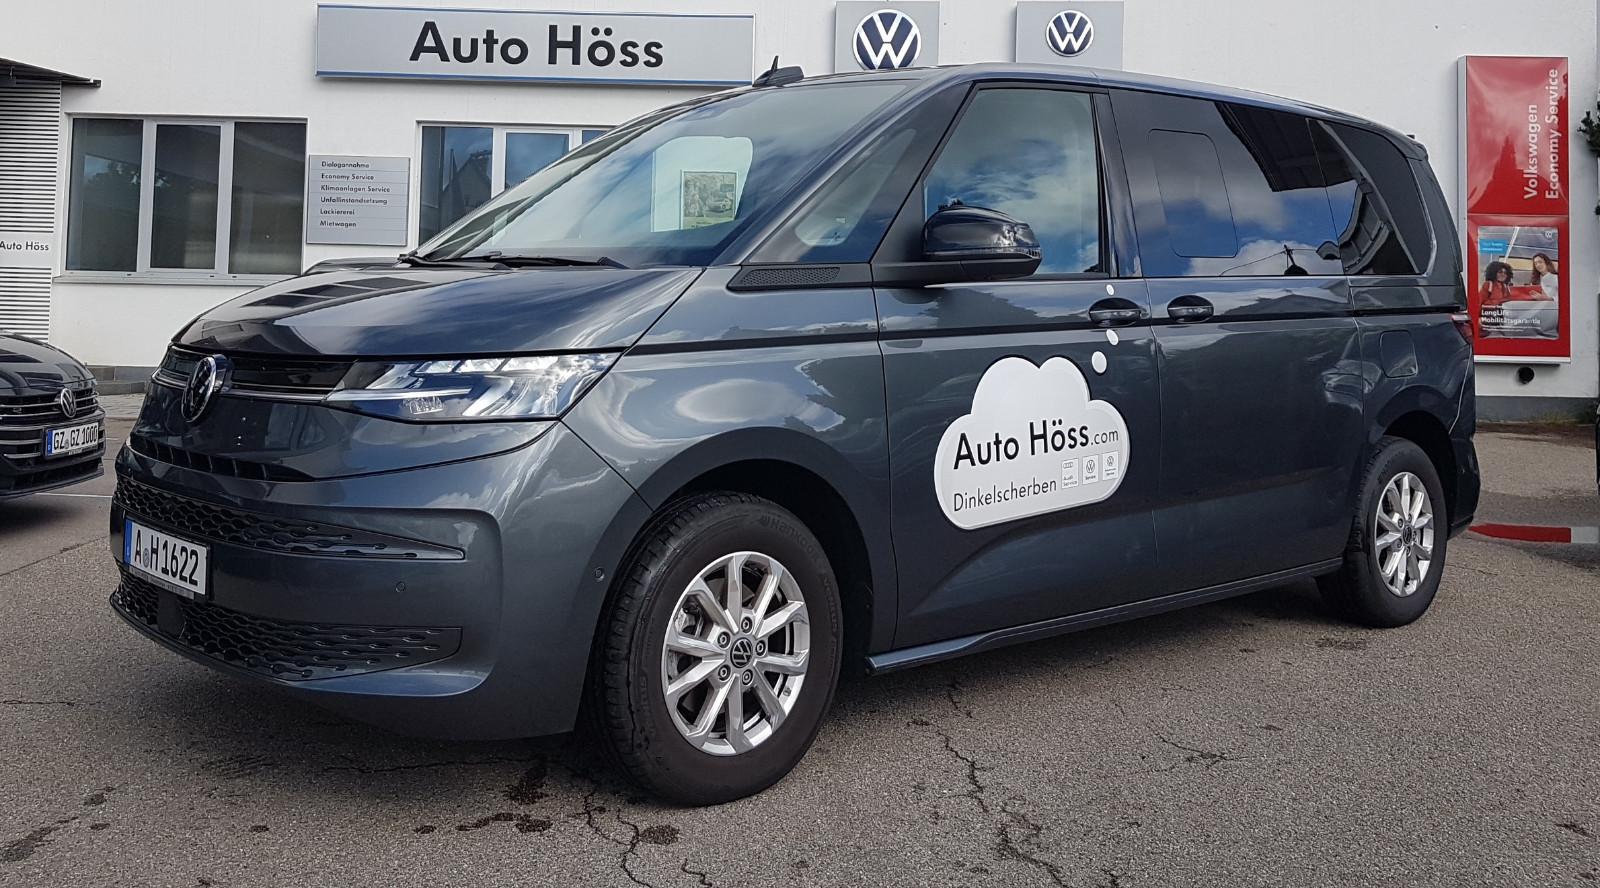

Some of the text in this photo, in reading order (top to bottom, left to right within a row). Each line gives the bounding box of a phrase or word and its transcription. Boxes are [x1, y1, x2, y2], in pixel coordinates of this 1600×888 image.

[409, 20, 664, 68] Auto Höss
[1523, 104, 1541, 200] Volkswagen
[1545, 68, 1562, 200] Economy Service
[320, 185, 366, 193] Klimaanlagen
[0, 240, 49, 250] Auto Höss
[53, 425, 98, 450] GZ GZ 1000
[953, 432, 1019, 469] Auto
[953, 476, 1058, 512] Dinkelscherben
[134, 529, 142, 564] A
